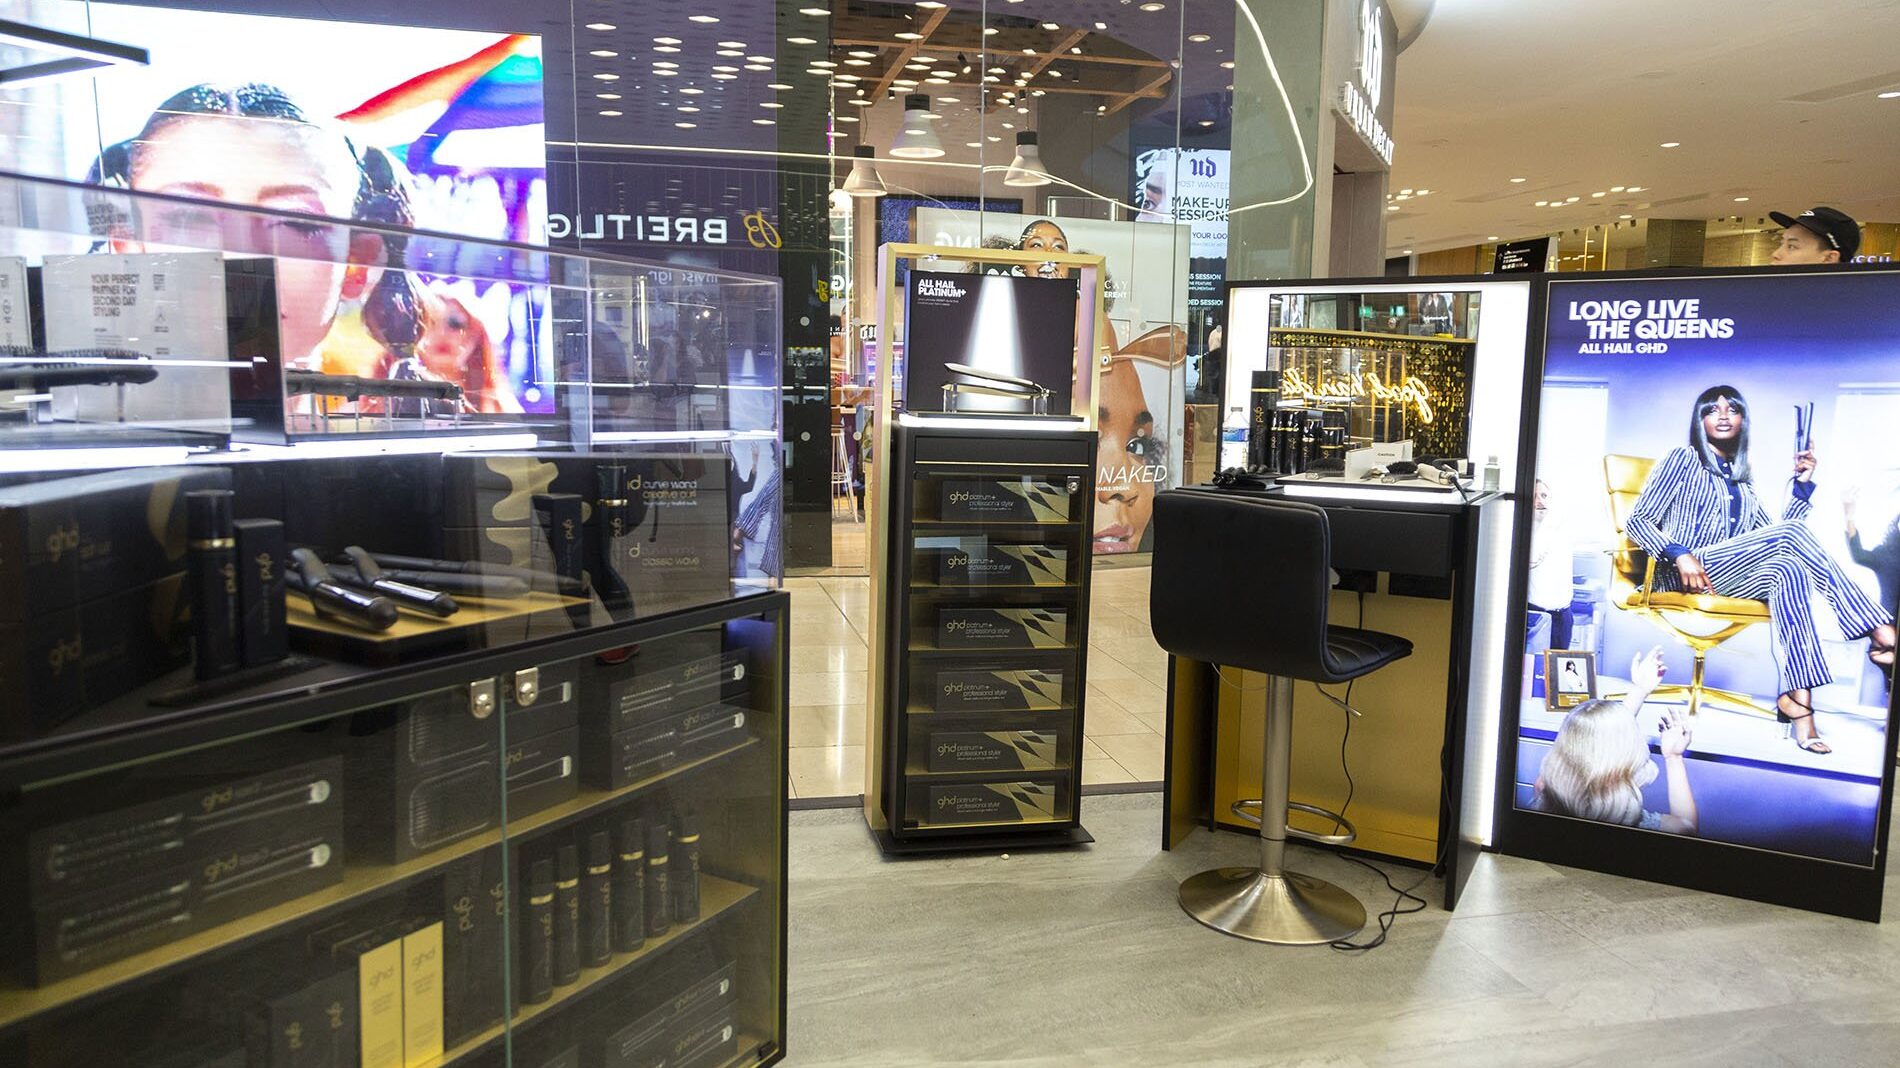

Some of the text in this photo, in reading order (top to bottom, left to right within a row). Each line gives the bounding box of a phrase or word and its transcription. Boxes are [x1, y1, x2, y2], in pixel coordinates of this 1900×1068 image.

[918, 279, 955, 289] ALL HAIL
[918, 287, 966, 297] PLATINUM+
[1569, 299, 1700, 320] LONG LIVE
[1586, 318, 1734, 339] THE QUEENS
[1578, 343, 1668, 354] ALL HAIL GHD
[1098, 465, 1167, 484] NAKED
[643, 480, 669, 489] curve
[671, 479, 697, 488] wand
[950, 491, 969, 504] ghd
[562, 518, 574, 540] ghd
[948, 555, 966, 568] ghd
[947, 619, 966, 632] ghd
[944, 682, 963, 696] ghd
[937, 743, 957, 757] ghd
[937, 796, 957, 809] ghd
